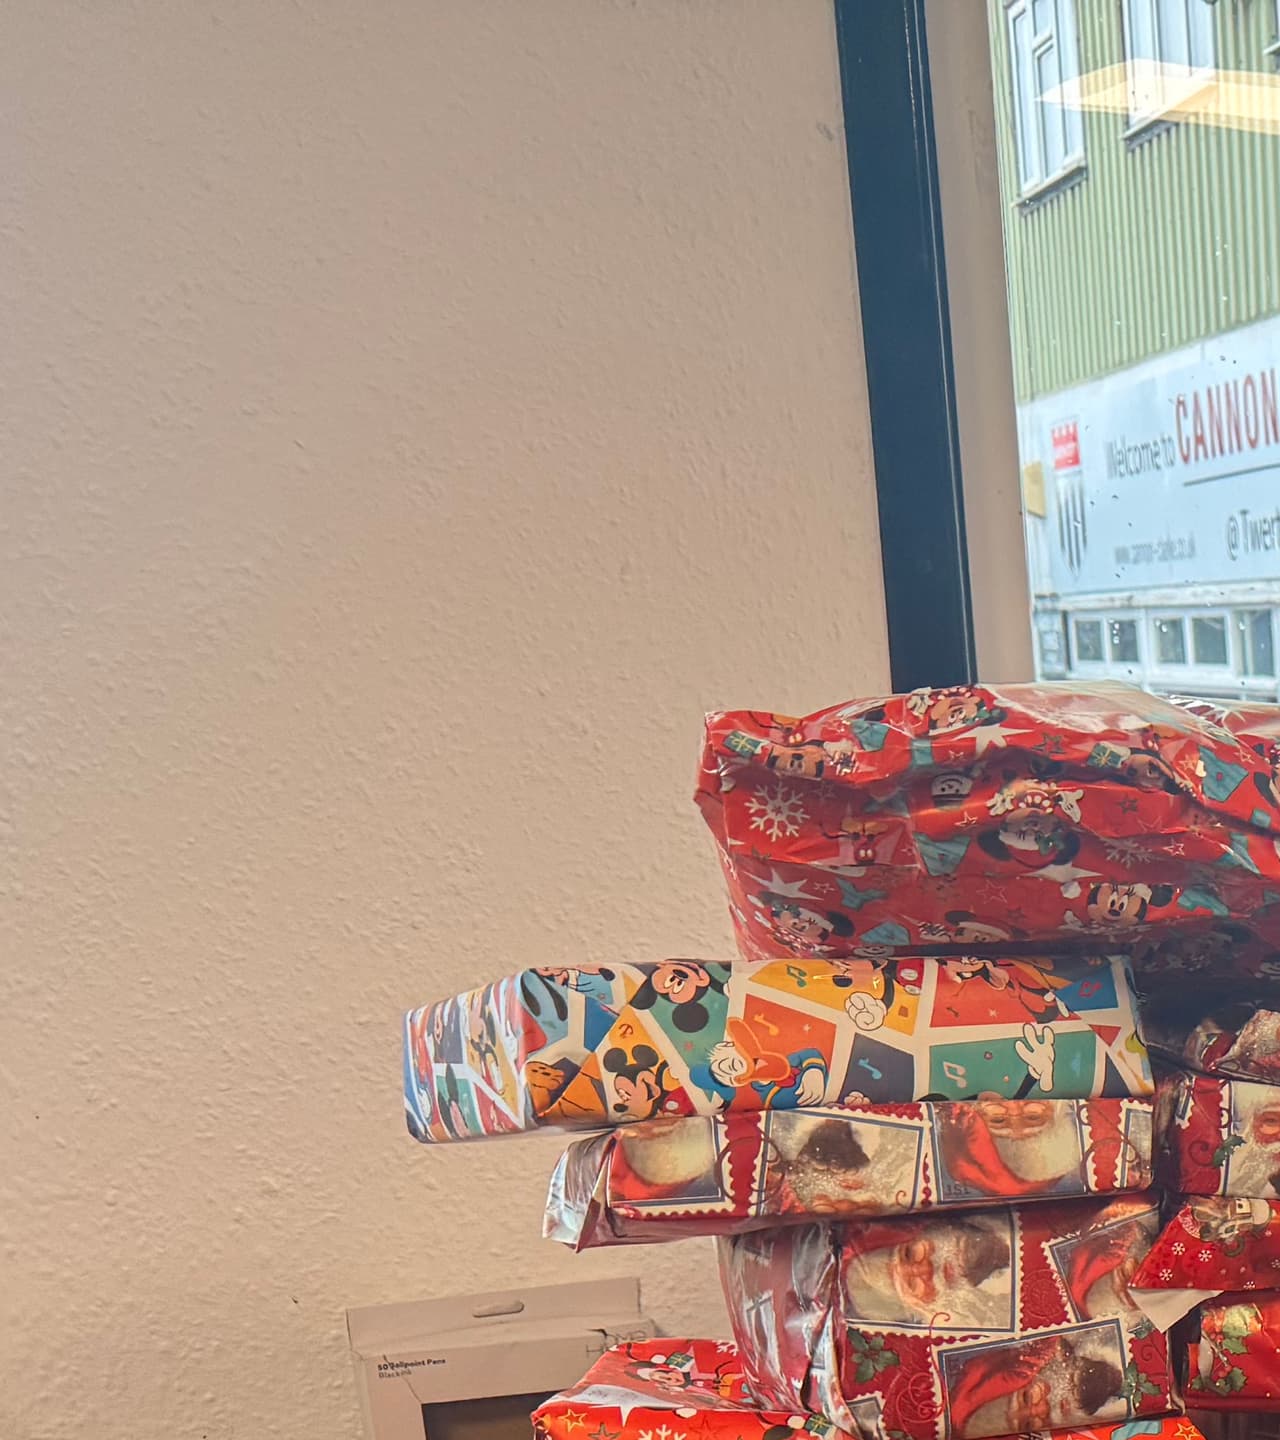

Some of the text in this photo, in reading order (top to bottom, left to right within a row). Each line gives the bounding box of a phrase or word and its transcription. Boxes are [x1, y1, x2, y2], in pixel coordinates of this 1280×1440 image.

[1107, 437, 1158, 480] Welcome
[1159, 435, 1175, 466] to
[378, 1363, 389, 1371] 50
[427, 1358, 446, 1367] Pens
